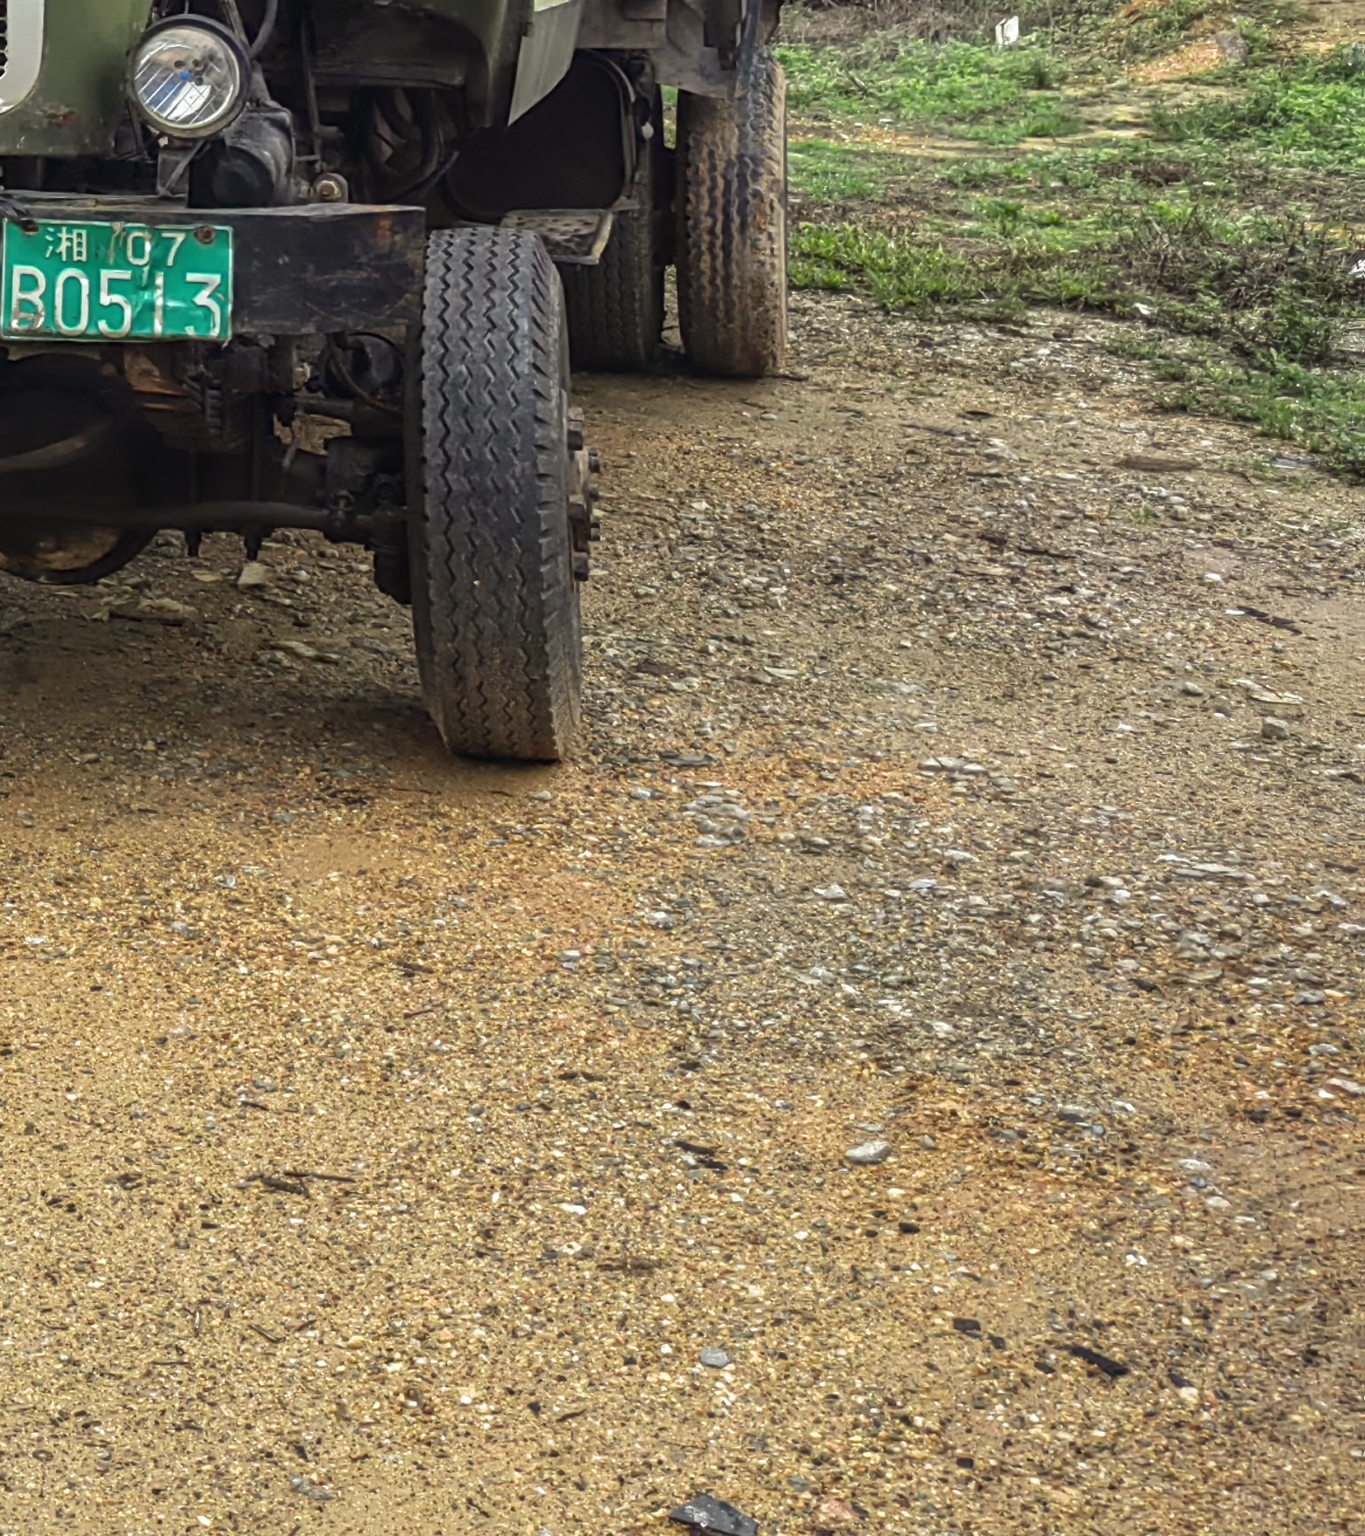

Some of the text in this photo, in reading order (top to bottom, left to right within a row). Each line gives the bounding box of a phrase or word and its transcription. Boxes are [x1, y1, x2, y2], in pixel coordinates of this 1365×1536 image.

[45, 226, 186, 267] 湘 07
[10, 264, 222, 339] B0513
